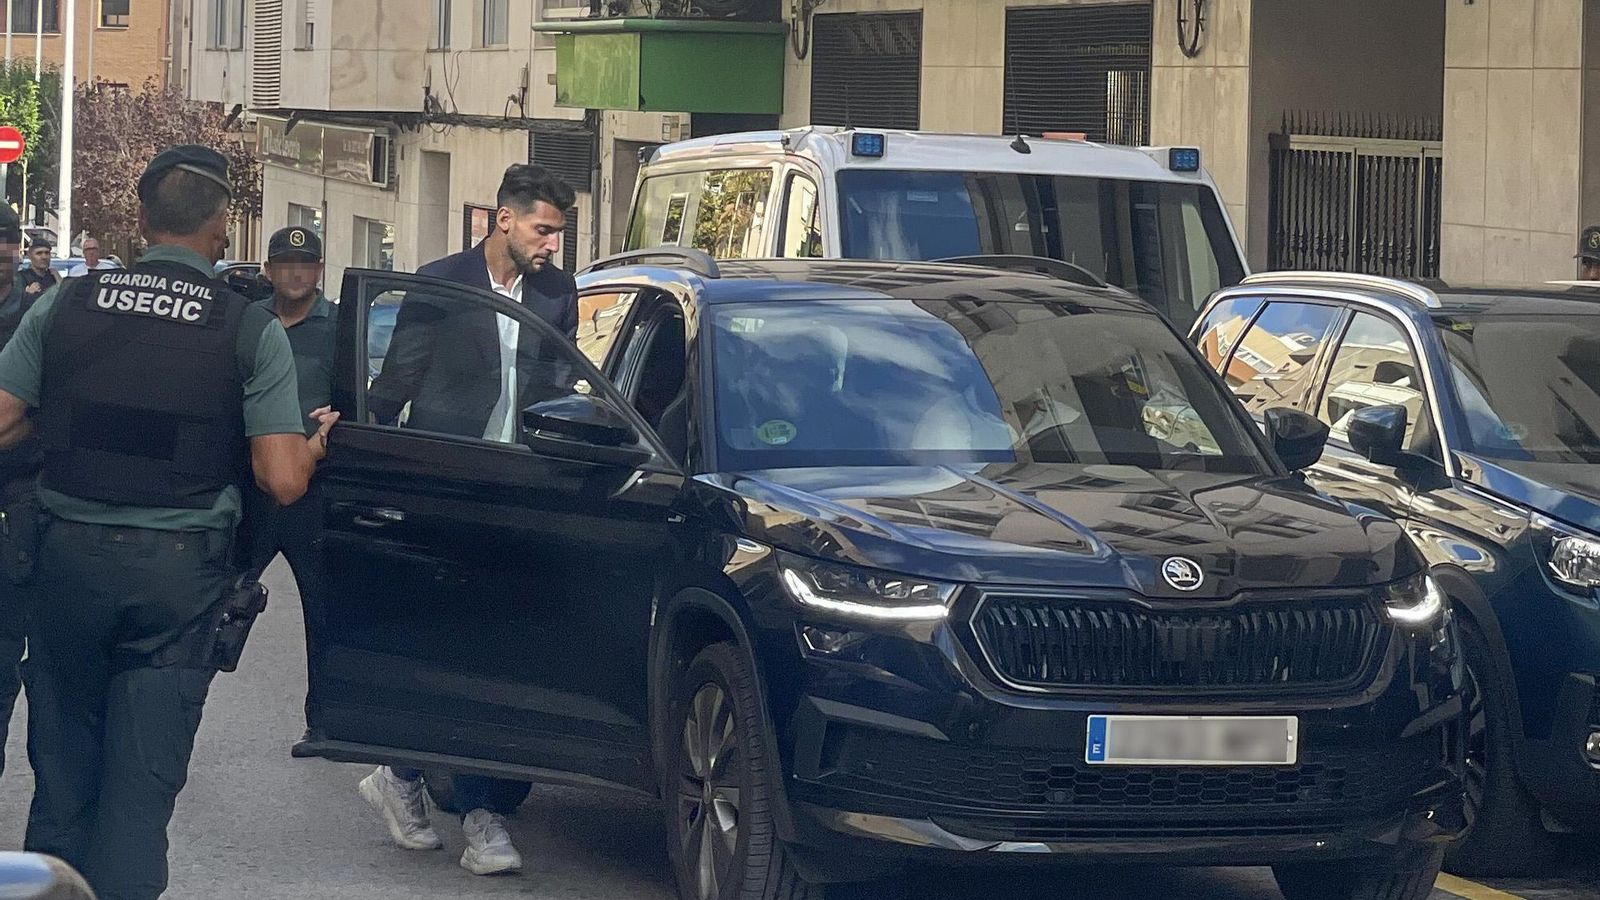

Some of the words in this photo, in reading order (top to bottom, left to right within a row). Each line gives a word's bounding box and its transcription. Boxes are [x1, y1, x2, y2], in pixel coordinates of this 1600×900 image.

[99, 273, 167, 290] GUARDIA
[171, 280, 213, 300] CIVIL
[97, 288, 203, 322] USECIC
[1092, 743, 1101, 754] E
